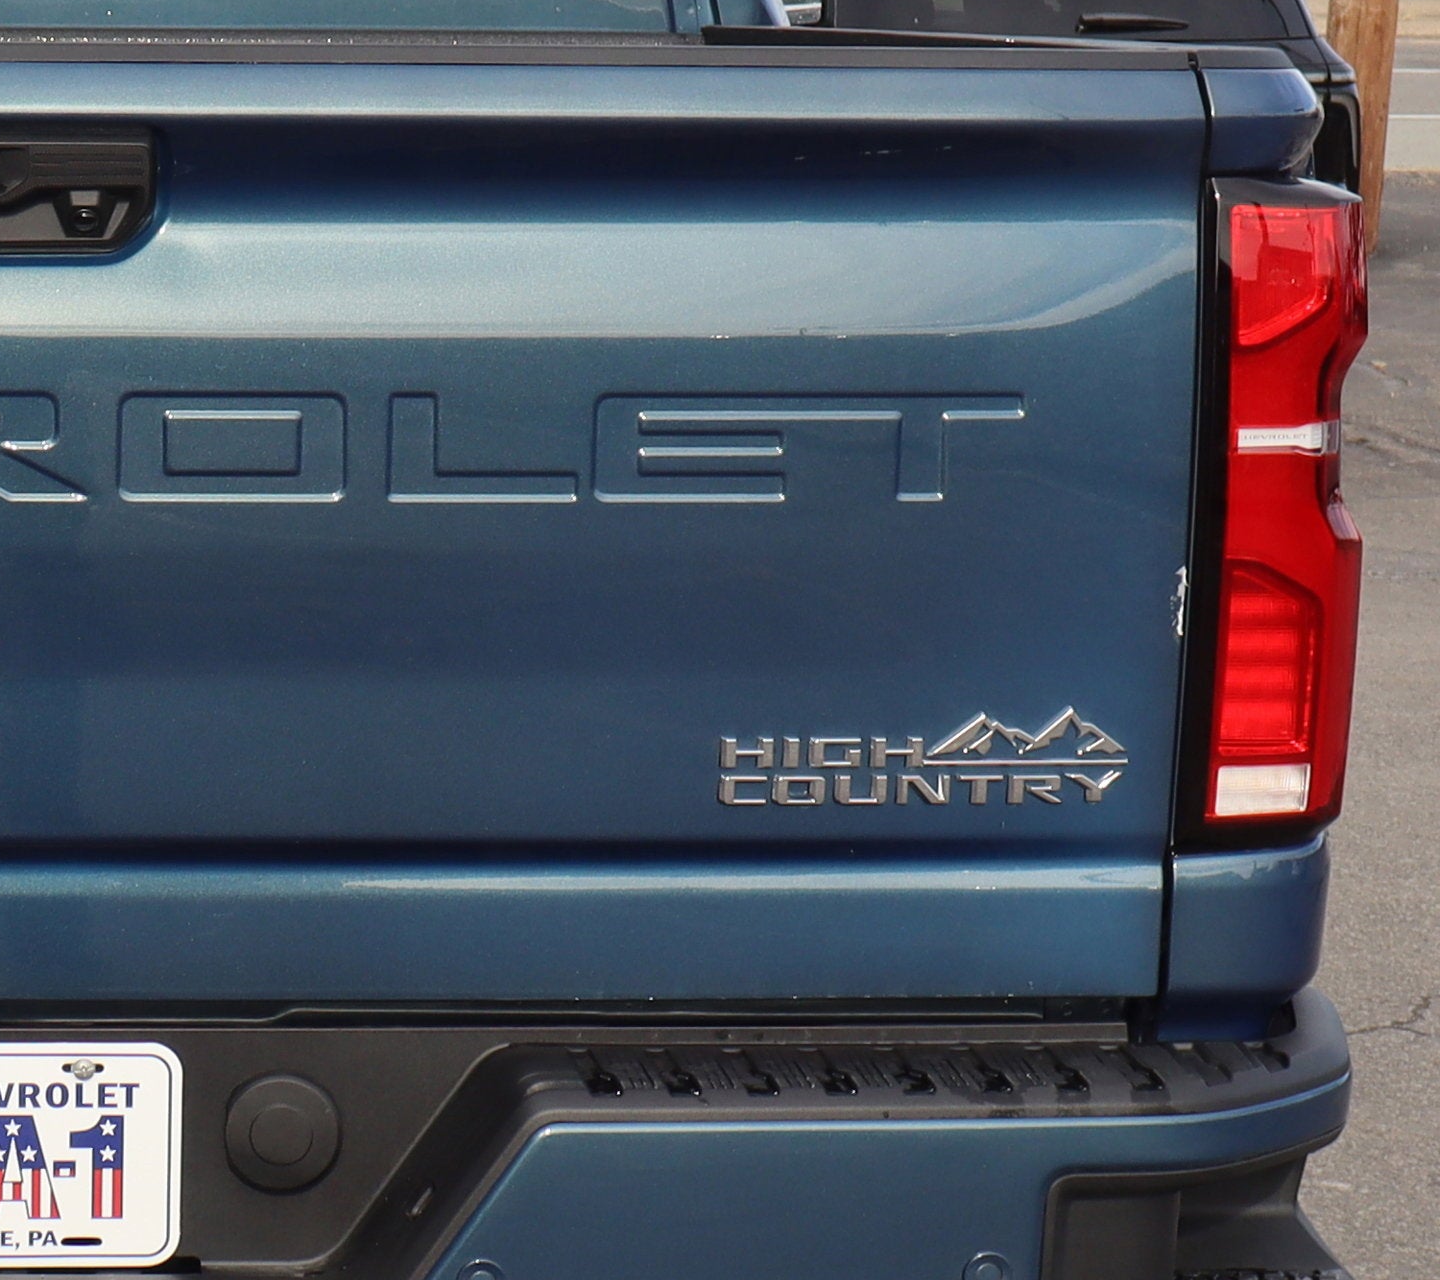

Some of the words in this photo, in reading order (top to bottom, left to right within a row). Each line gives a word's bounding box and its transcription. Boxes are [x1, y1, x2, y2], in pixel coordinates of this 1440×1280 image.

[720, 735, 923, 769] HIGH
[718, 770, 1123, 805] COUNTRY
[27, 1230, 59, 1247] PA
